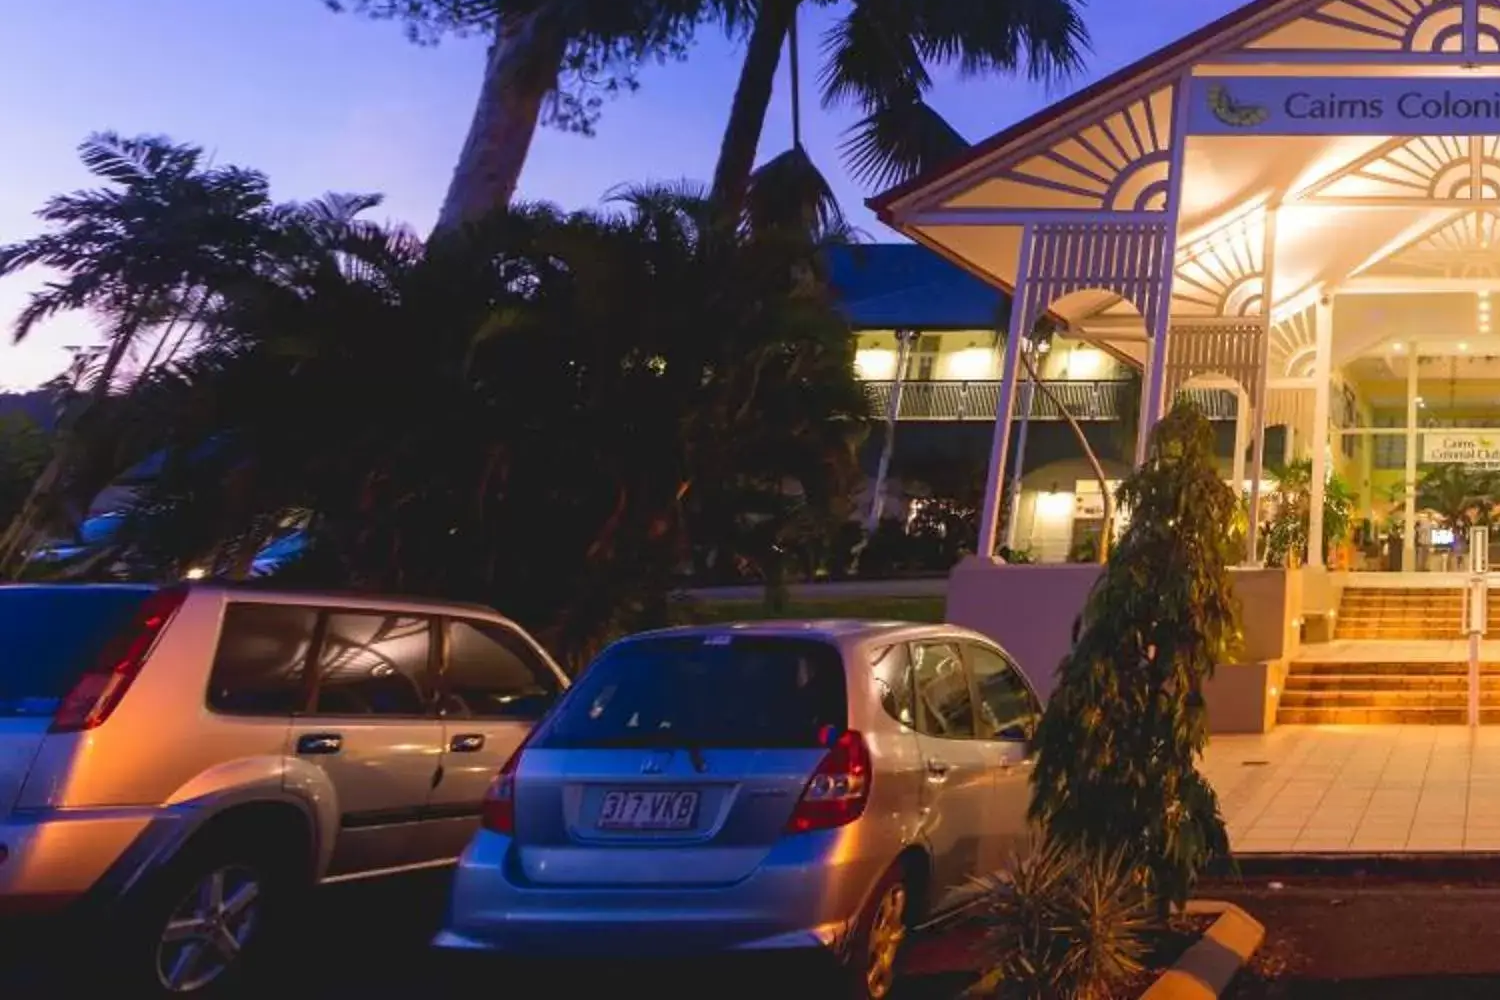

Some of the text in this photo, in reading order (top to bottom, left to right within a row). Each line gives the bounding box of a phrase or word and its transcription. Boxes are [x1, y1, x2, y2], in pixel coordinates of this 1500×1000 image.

[1283, 91, 1384, 120] Cairns
[1442, 438, 1476, 449] Cairns
[1431, 448, 1475, 460] Colonial
